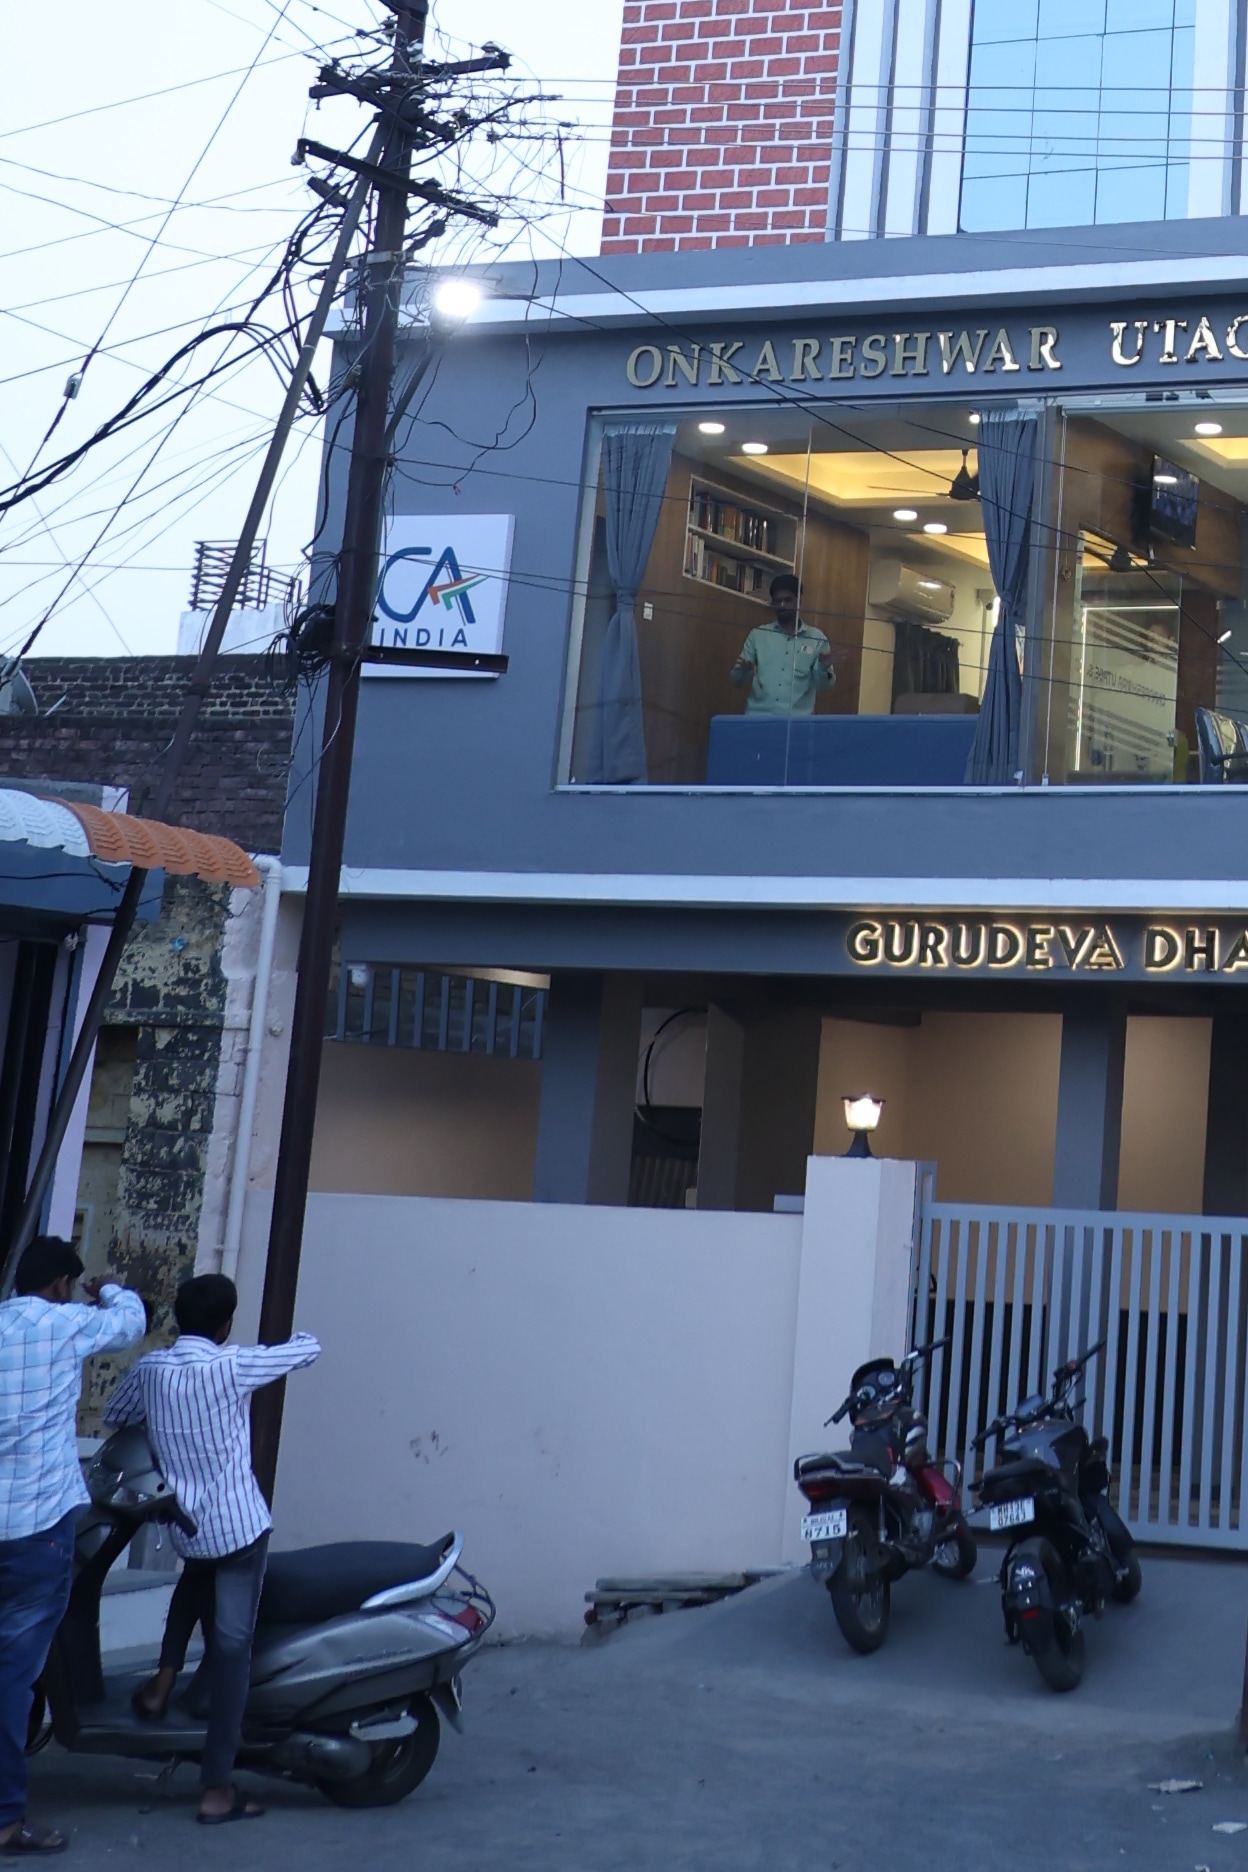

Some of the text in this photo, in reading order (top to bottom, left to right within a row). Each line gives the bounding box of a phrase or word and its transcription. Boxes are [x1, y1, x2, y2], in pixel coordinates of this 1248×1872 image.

[626, 327, 1061, 388] ONKARESHWAR
[379, 628, 468, 647] INDIA
[846, 920, 1125, 971] GURUDEVA
